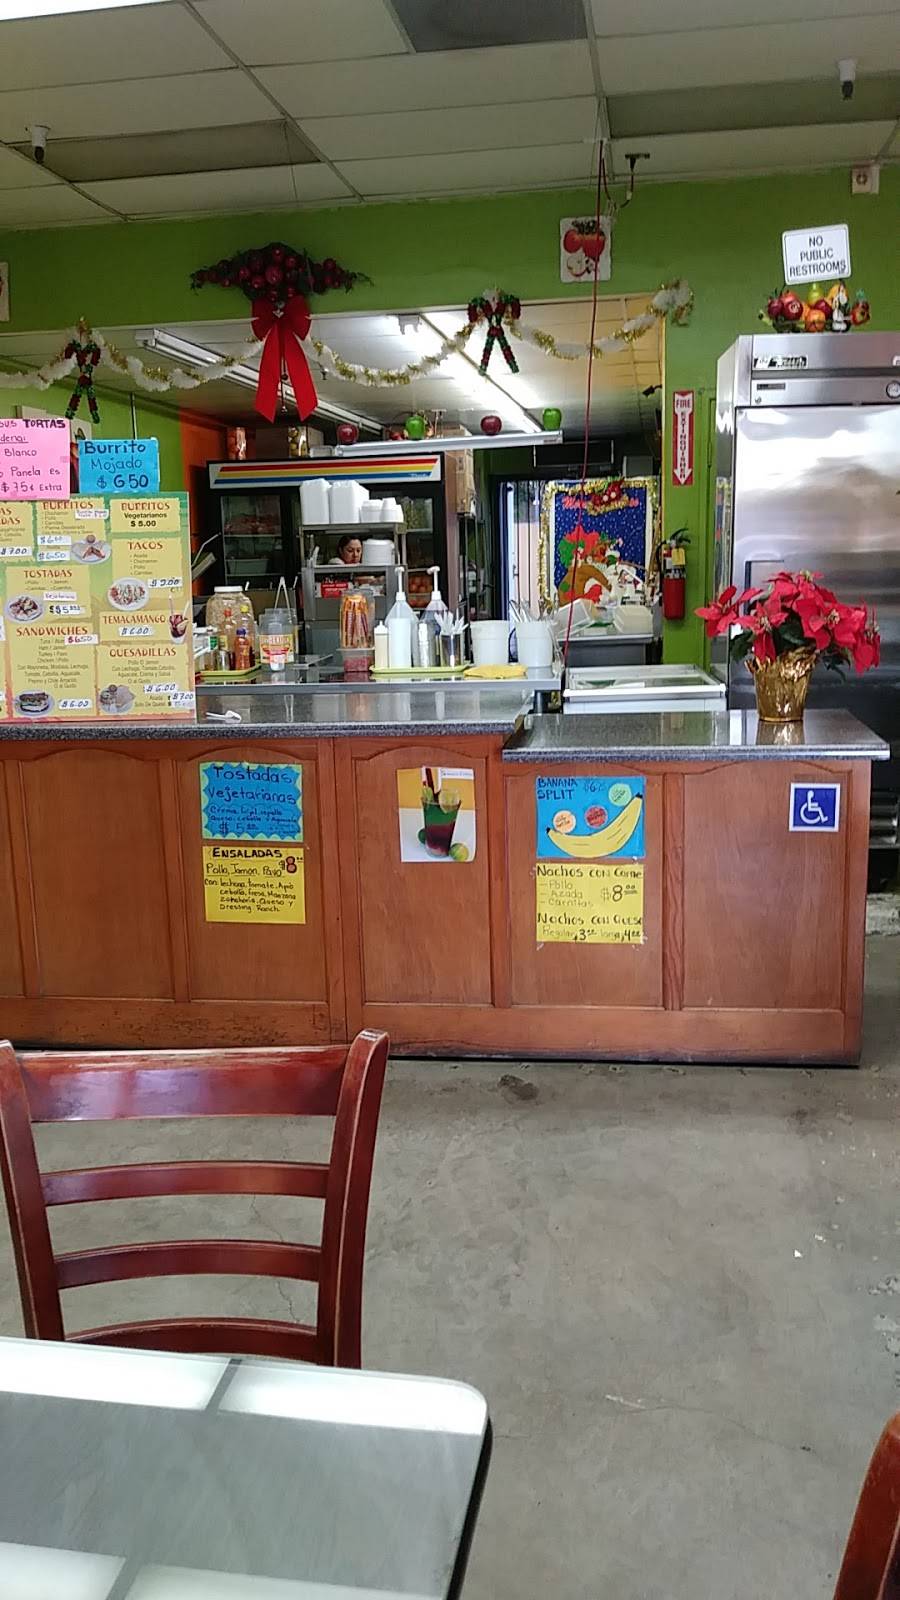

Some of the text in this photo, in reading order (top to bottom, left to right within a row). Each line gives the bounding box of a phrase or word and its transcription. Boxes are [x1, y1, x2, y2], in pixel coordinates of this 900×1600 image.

[808, 235, 823, 247] NO
[800, 248, 833, 262] PUBLIC
[789, 260, 846, 277] RESTROOMS
[676, 399, 690, 408] FIRE
[23, 419, 66, 428] TORTAS
[4, 448, 37, 456] Blanco
[84, 440, 146, 454] Burrito
[91, 456, 143, 473] Mojado
[11, 466, 41, 477] Panela
[121, 502, 170, 511] BURRITOS
[127, 542, 163, 550] TACOS
[24, 570, 73, 578] TOSTADAS
[16, 626, 88, 636] SANDWICHES
[109, 647, 177, 657] QUESADILLAS
[213, 765, 292, 784] Tostadas
[538, 777, 578, 788] BANANA
[208, 785, 297, 805] Vejetarianas
[537, 789, 574, 800] SPLIT
[212, 847, 283, 858] ENSALADAS
[537, 865, 583, 877] Nachos
[614, 867, 642, 878] Carne
[537, 912, 584, 925] Nachos
